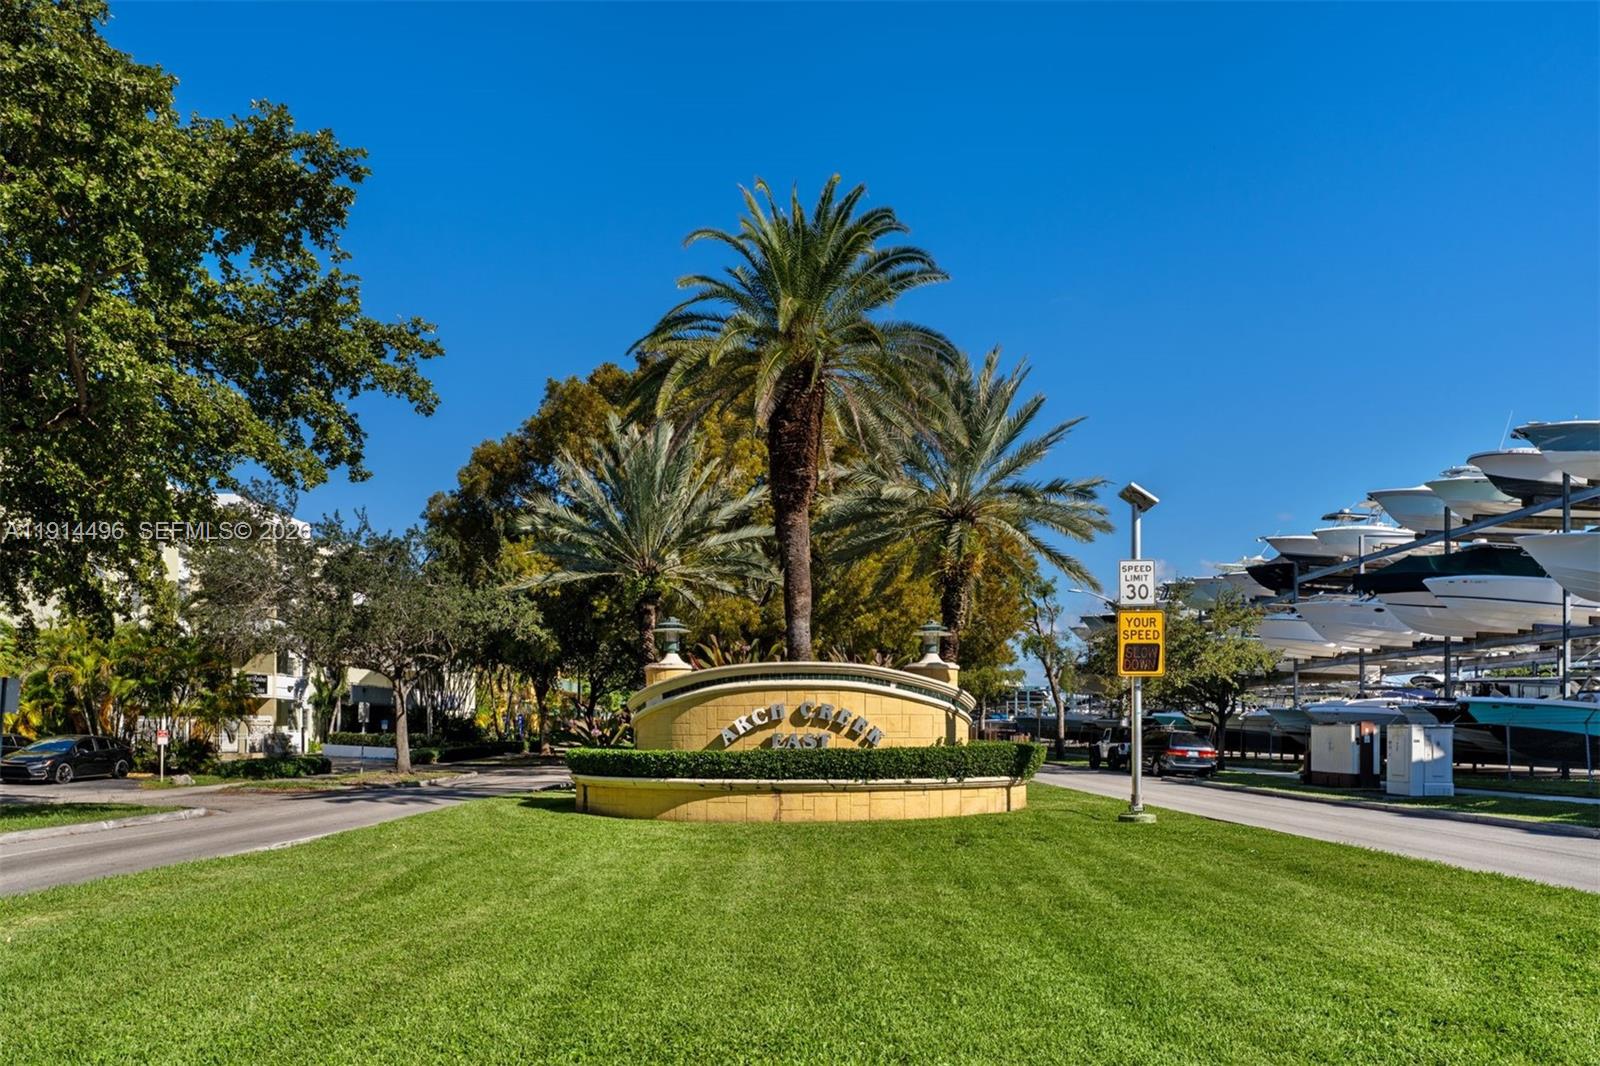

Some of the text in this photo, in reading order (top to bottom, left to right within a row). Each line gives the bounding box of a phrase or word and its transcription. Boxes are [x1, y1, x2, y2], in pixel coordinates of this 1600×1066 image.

[1121, 565, 1152, 573] SPEED
[1125, 574, 1149, 582] LIMIT
[1126, 584, 1149, 600] 30
[1125, 617, 1157, 628] YOUR
[1122, 630, 1160, 640] SPEED
[1126, 647, 1158, 658] SLOW
[720, 701, 885, 747] ARCH CREEK
[771, 733, 831, 749] EAST
